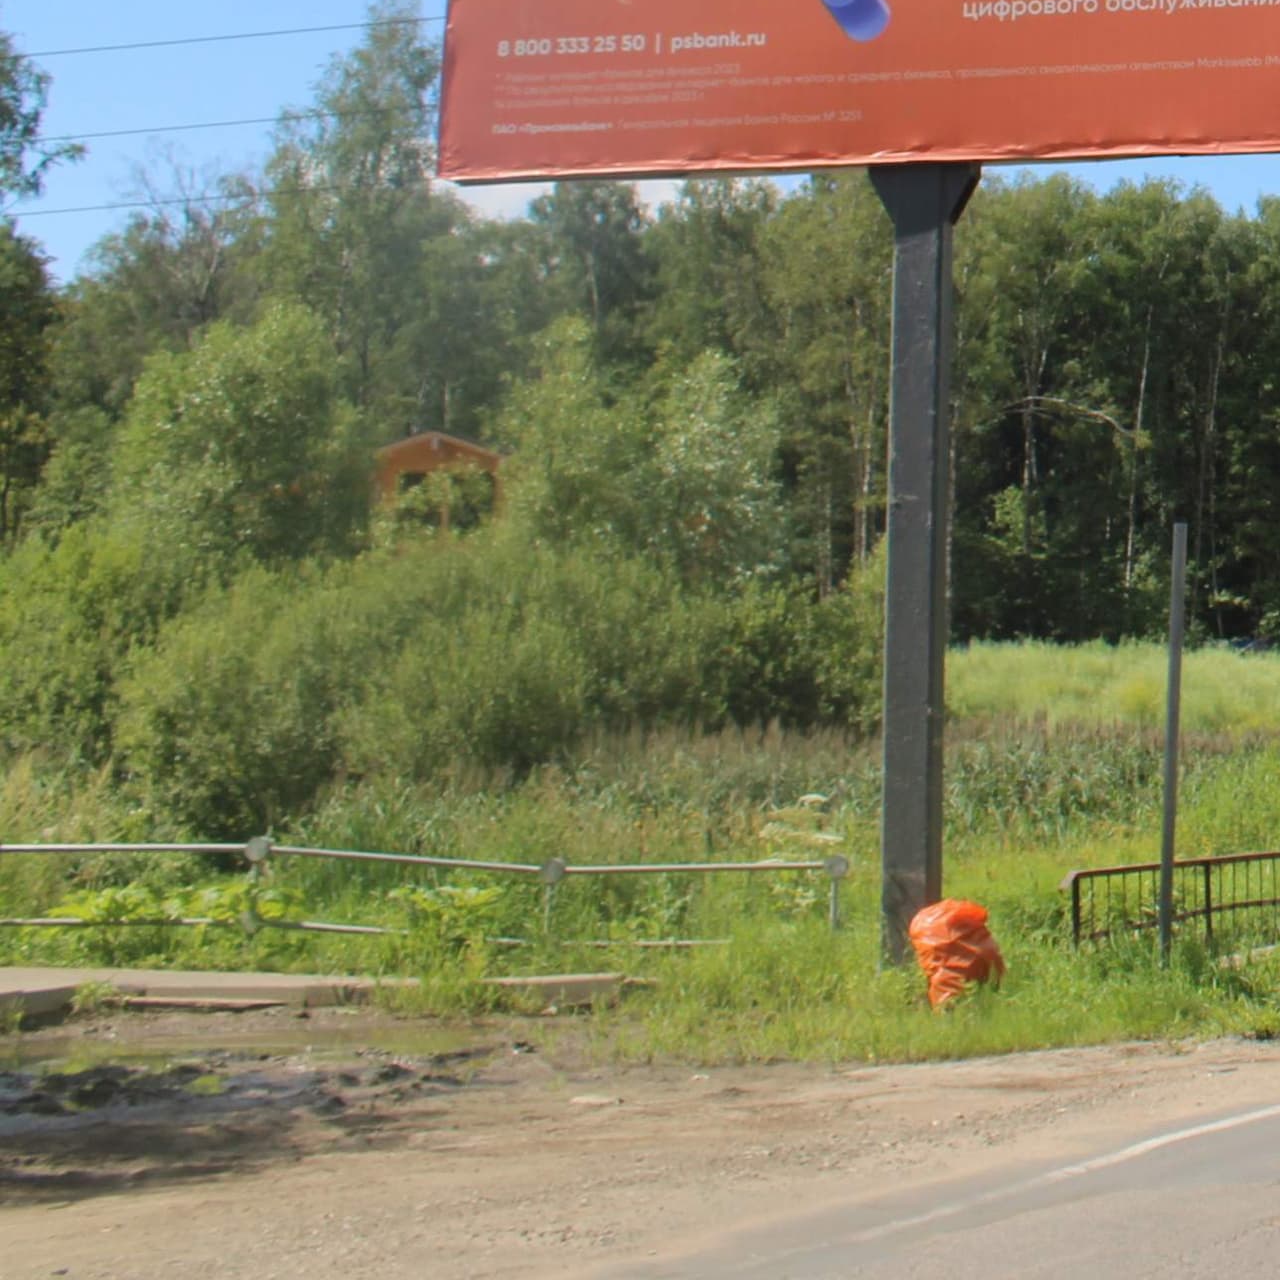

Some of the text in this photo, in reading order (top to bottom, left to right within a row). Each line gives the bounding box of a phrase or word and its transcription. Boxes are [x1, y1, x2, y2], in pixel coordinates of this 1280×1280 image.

[497, 31, 767, 57] 8 800 333 25 50 psbank.ru
